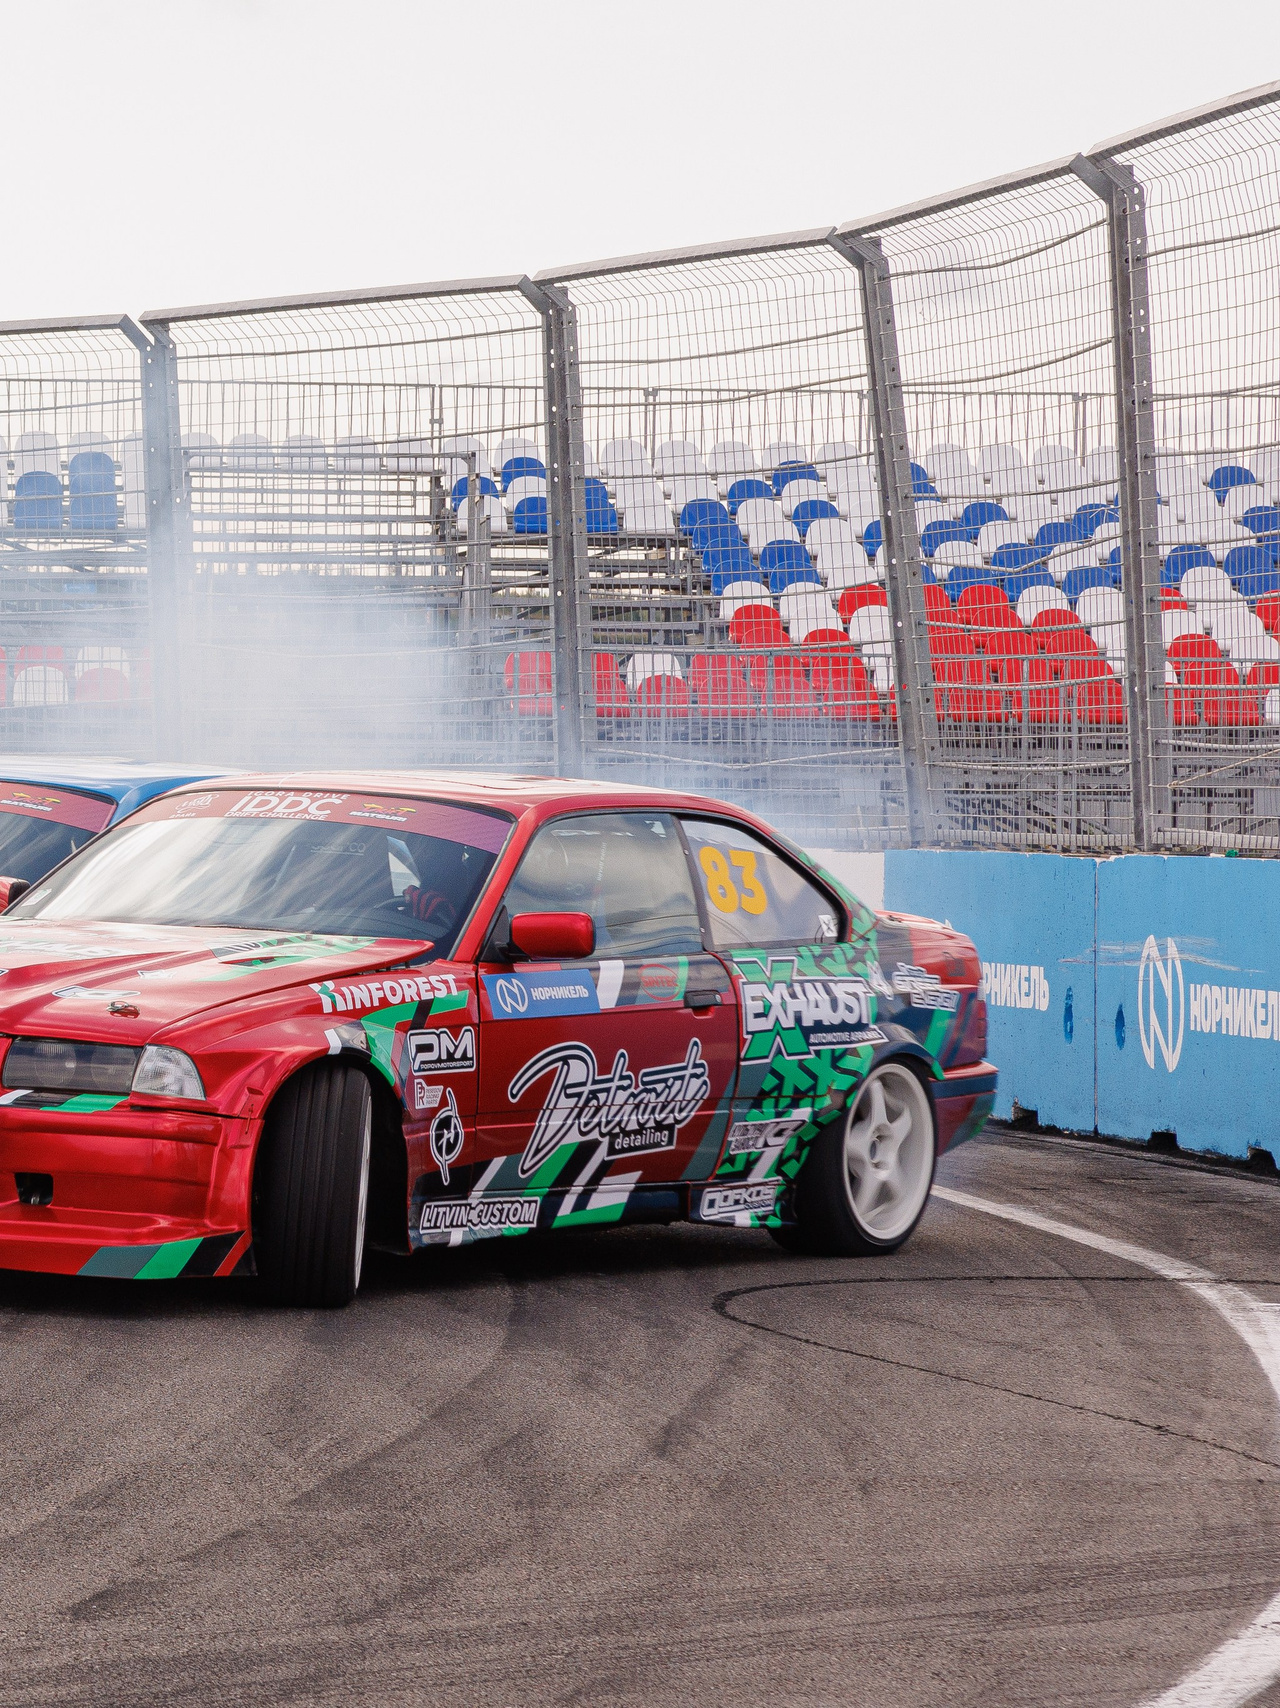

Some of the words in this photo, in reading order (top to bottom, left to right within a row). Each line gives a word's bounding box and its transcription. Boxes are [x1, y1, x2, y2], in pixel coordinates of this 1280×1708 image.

[229, 796, 343, 815] IDDC
[302, 792, 350, 800] DRIVE
[259, 811, 329, 821] CHALLENGE
[698, 845, 768, 916] 83
[531, 984, 589, 1001] НОРНИКЕЛЬ
[982, 962, 1050, 1012] РНИКЕЛЬ
[745, 981, 871, 1032] EXHAUST
[1190, 983, 1280, 1042] НОРНИКЕЛ
[809, 1032, 850, 1044] AUTOMOTIVE
[614, 1128, 669, 1150] detailing
[471, 1201, 536, 1224] CUSTOM
